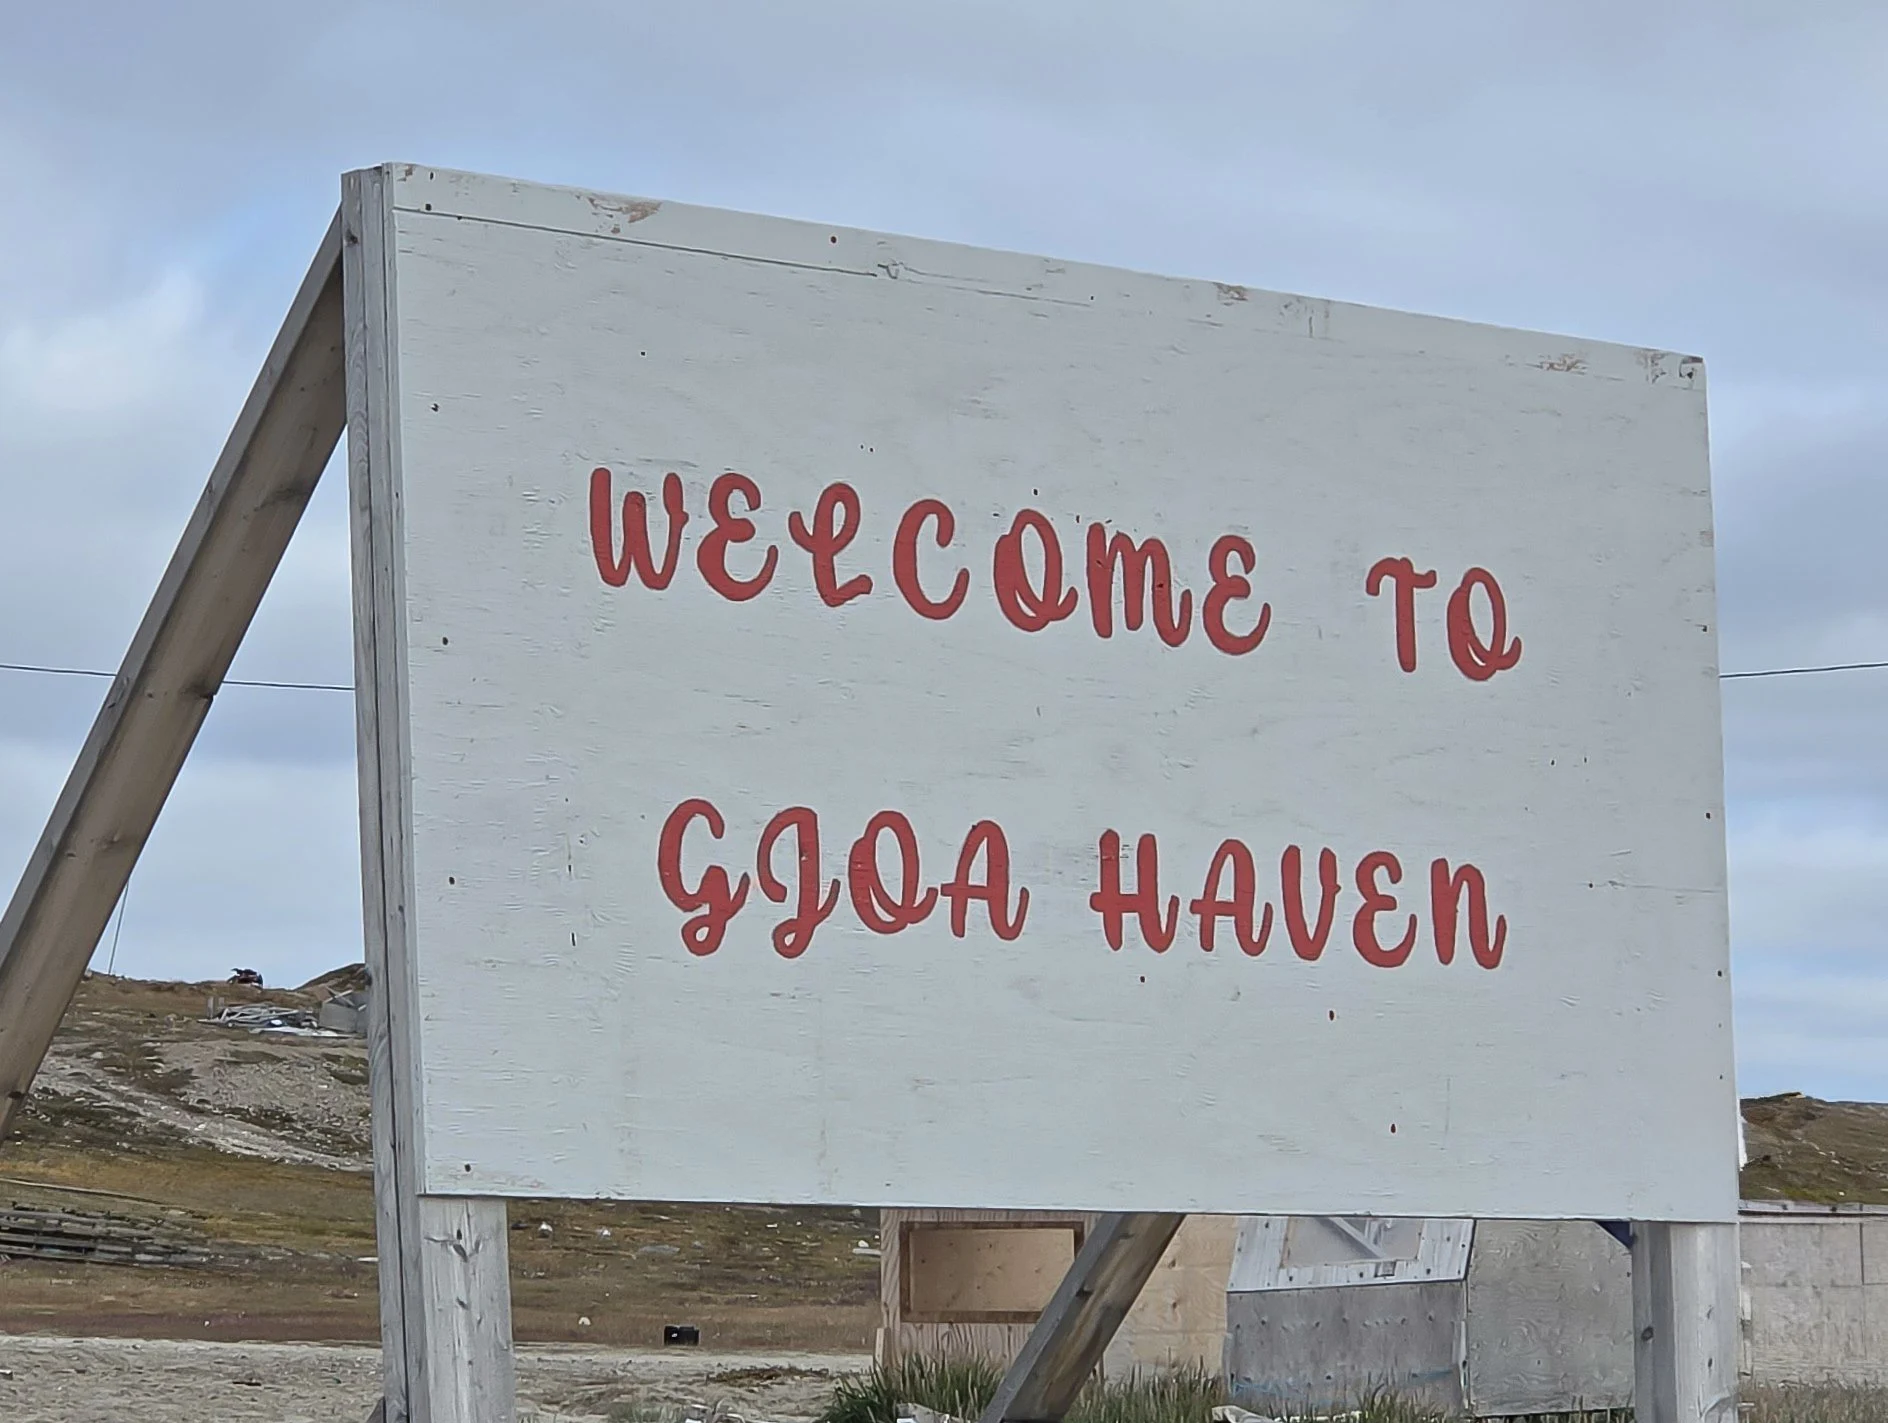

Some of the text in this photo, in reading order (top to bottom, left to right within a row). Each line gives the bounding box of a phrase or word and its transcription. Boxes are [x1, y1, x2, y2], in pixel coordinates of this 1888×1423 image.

[590, 468, 1521, 680] WELCOME TO
[658, 799, 1506, 969] GJOA HAVEN
